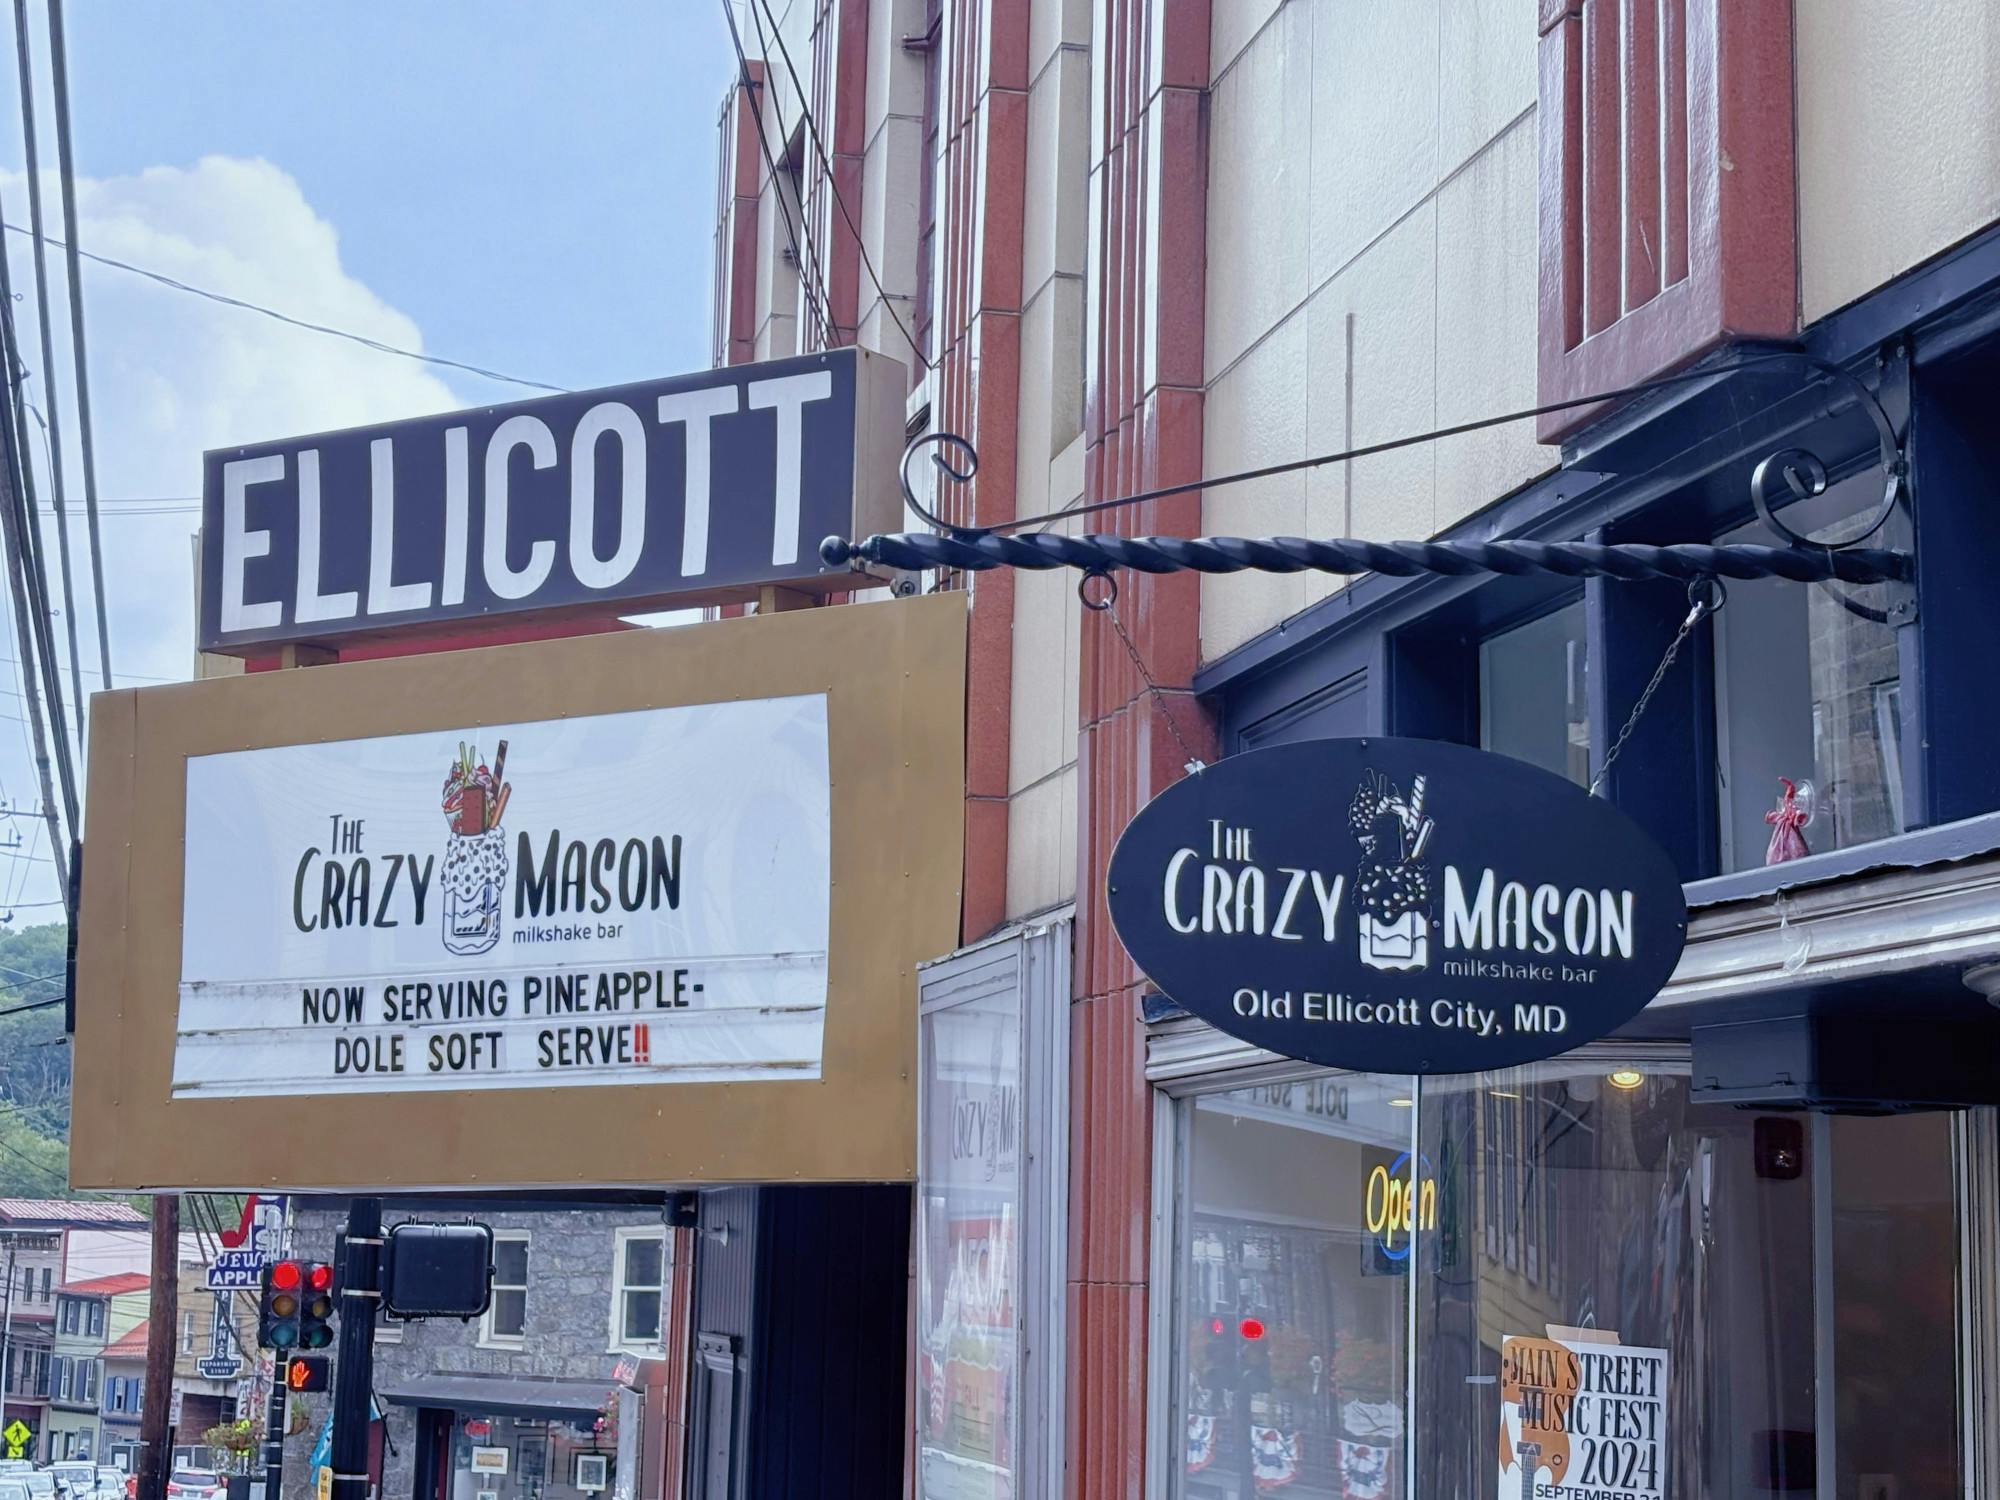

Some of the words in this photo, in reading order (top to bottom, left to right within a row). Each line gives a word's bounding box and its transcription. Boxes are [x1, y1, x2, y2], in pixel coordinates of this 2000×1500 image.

[220, 371, 832, 633] ELLICOTT
[330, 814, 366, 855] THE
[1208, 819, 1253, 861] THE
[293, 847, 435, 932] CRAZY
[514, 828, 682, 919] MASON
[1164, 848, 1344, 941] CRAZY
[1444, 865, 1632, 958] MASON
[513, 924, 591, 944] milkshake
[597, 923, 623, 938] bar
[303, 987, 364, 1024] NOW
[383, 979, 508, 1022] SERVING
[524, 969, 704, 1015] PINEAPPLE-
[1443, 958, 1554, 981] milkshake
[1561, 964, 1598, 983] bar
[1232, 988, 1291, 1019] Old
[1303, 991, 1422, 1026] Ellicott
[1430, 999, 1503, 1037] City,
[1514, 1003, 1567, 1033] MD
[334, 1034, 404, 1073] DOLE
[428, 1031, 503, 1072] SOFT
[537, 1023, 649, 1068] SERVE!!
[1366, 1165, 1436, 1248] Open
[1510, 1346, 1559, 1388] MAIN
[1566, 1352, 1663, 1397] STREET
[1521, 1388, 1592, 1435] MUSIC
[1599, 1397, 1661, 1441] FEST
[1580, 1437, 1659, 1491] 2024
